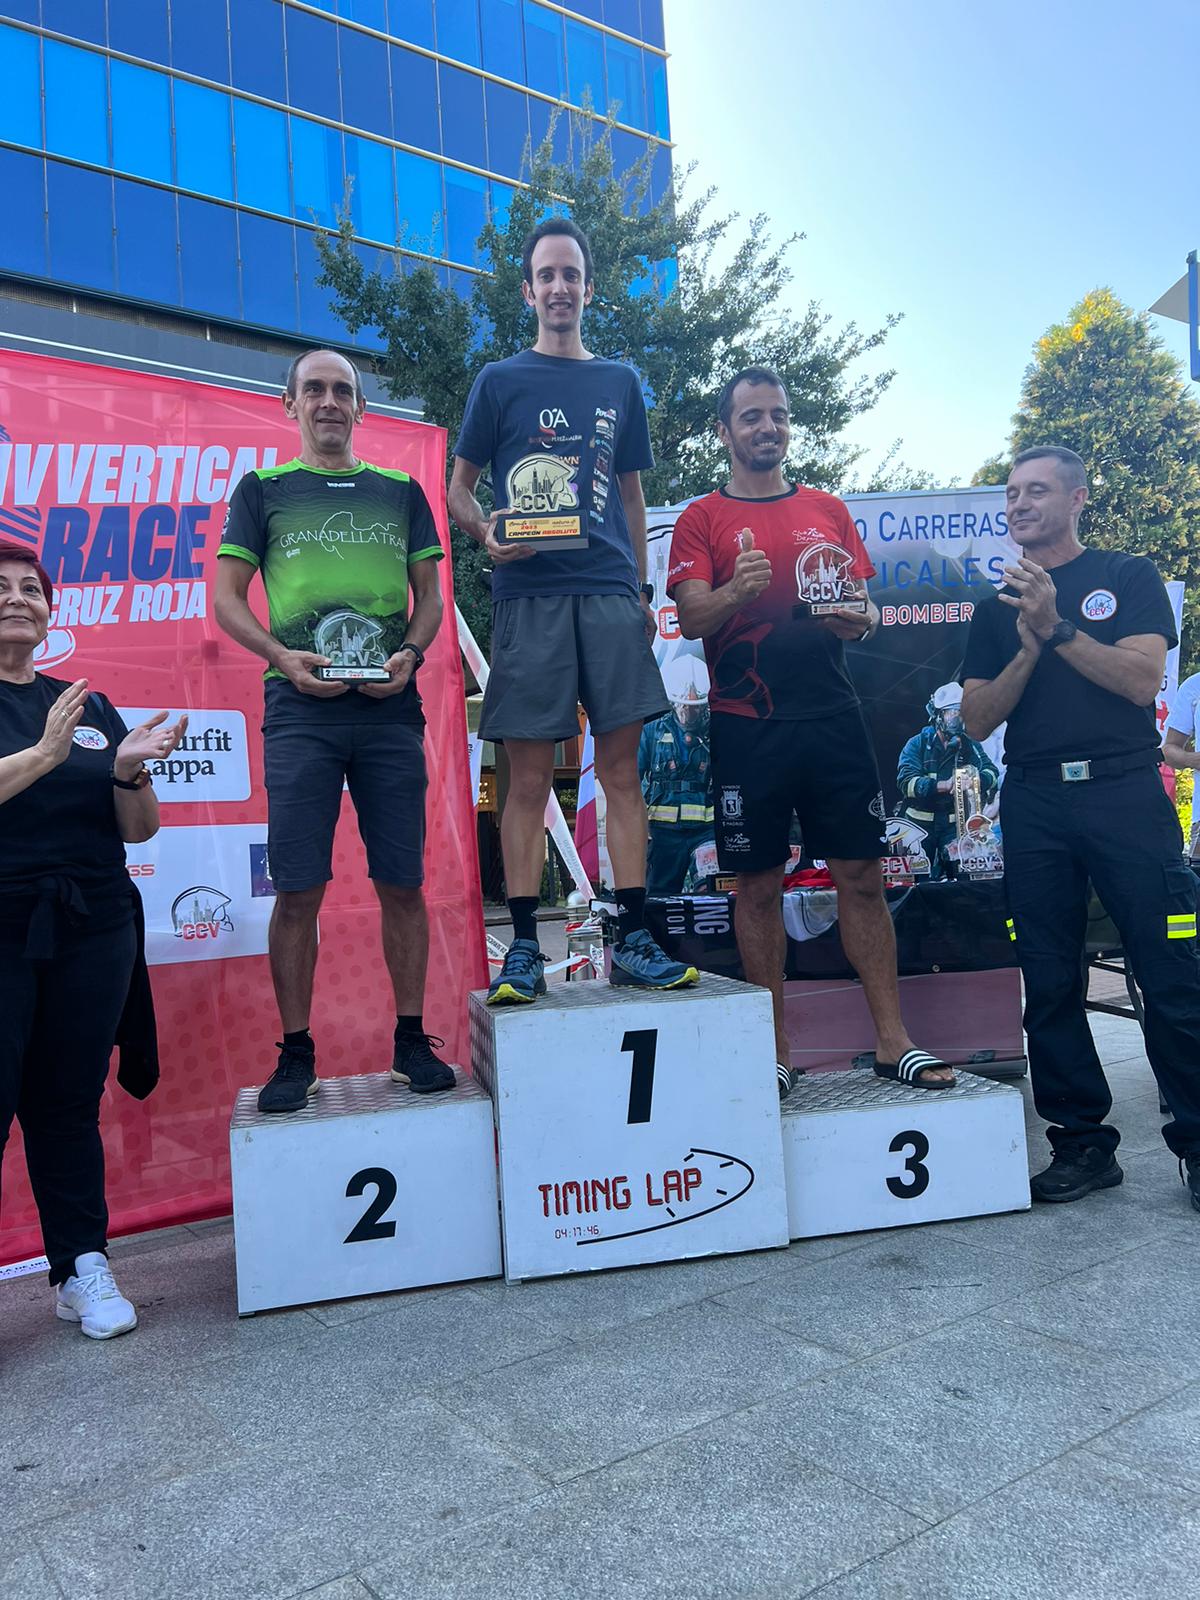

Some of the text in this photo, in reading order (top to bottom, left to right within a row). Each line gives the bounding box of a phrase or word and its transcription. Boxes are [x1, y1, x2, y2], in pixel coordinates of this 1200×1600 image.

[520, 494, 559, 511] CCV
[879, 511, 1008, 542] CARRERAS
[41, 504, 212, 585] RACE
[873, 556, 1006, 590] ICALES
[129, 581, 207, 622] ROJA
[809, 581, 843, 601] CCV
[329, 650, 370, 667] CCV
[325, 669, 331, 677] 2
[172, 728, 232, 752] urfit
[149, 759, 216, 783] appa
[182, 922, 221, 941] CCV
[620, 1028, 659, 1125] 1
[885, 1129, 930, 1200] 3
[342, 1166, 398, 1245] 2
[537, 1167, 702, 1217] TIMING LAP
[554, 1224, 600, 1240] 04:17:46
